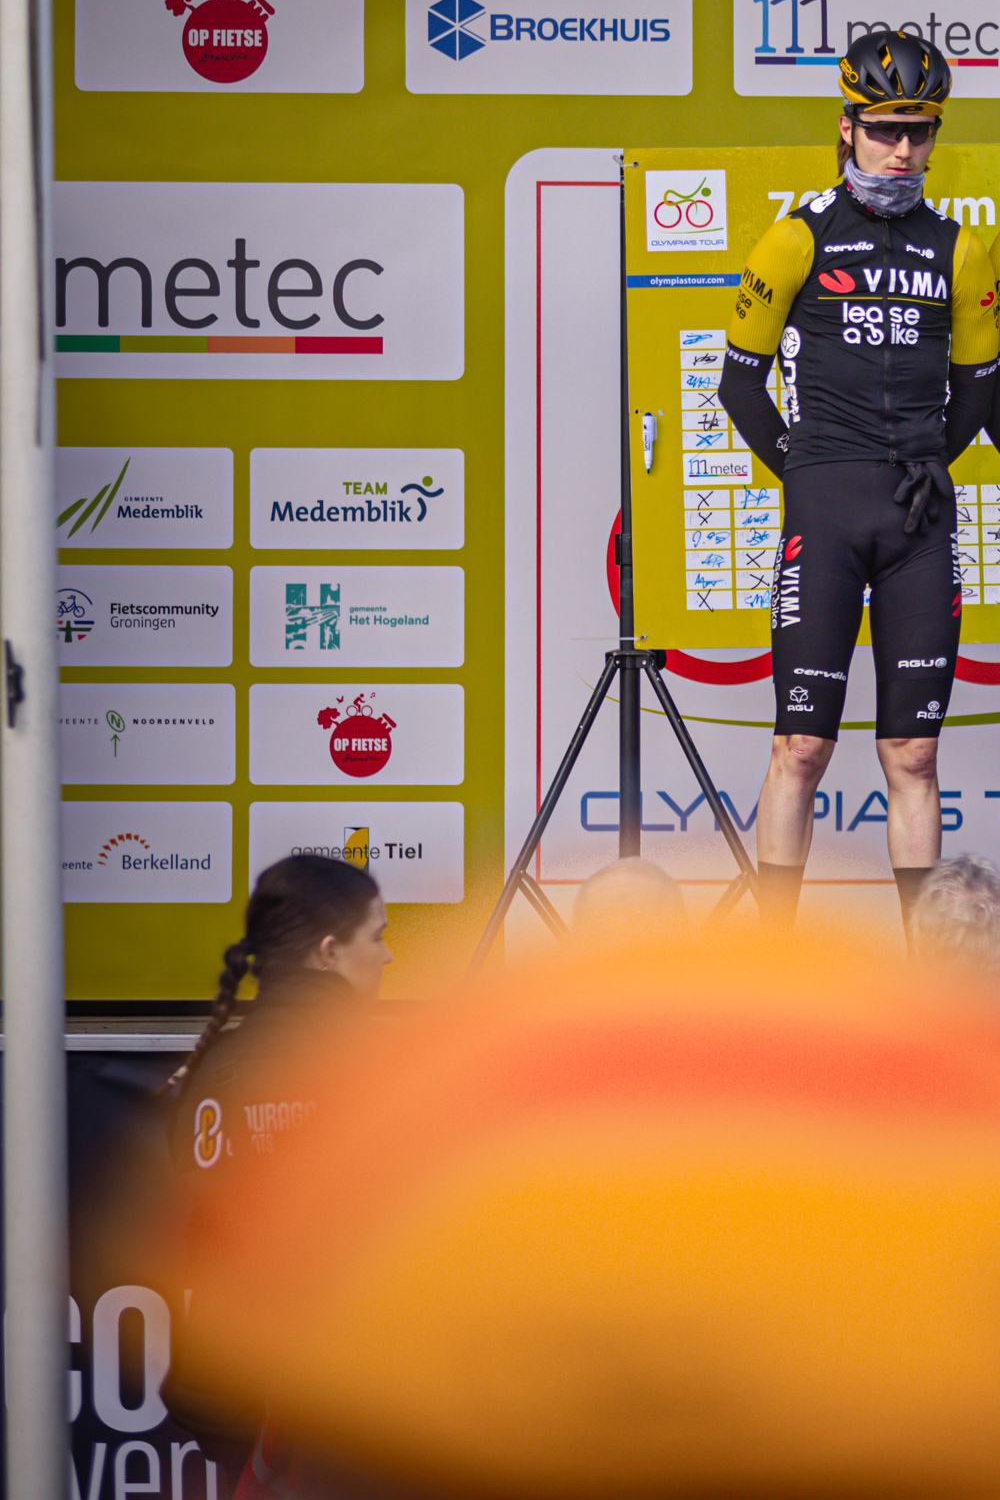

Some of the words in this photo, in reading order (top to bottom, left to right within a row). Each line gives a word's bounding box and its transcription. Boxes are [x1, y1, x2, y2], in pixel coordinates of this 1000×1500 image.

[490, 14, 671, 43] BROEKHUIS
[188, 29, 209, 47] OP
[212, 29, 262, 47] FIETSE
[651, 239, 695, 247] OLYMPIA'S
[55, 238, 385, 330] metec
[650, 276, 725, 287] olympiastour.com
[743, 266, 773, 305] VISMA
[863, 268, 948, 299] VISMA
[843, 302, 920, 325] lease
[710, 463, 748, 475] metec
[343, 482, 388, 495] TEAM
[117, 505, 203, 519] Medemblik
[270, 500, 412, 522] Medemblik
[780, 565, 801, 628] VISMA
[110, 603, 219, 617] Fietscommunity
[110, 616, 175, 630] Groningen
[349, 615, 370, 625] Het
[373, 615, 429, 627] Hogeland
[898, 659, 935, 668] AGU
[787, 704, 814, 712] AGU
[917, 711, 944, 719] AGU
[334, 738, 349, 751] OP
[352, 738, 387, 751] FIETSE
[384, 843, 422, 859] Tiel
[122, 854, 211, 870] Berkelland
